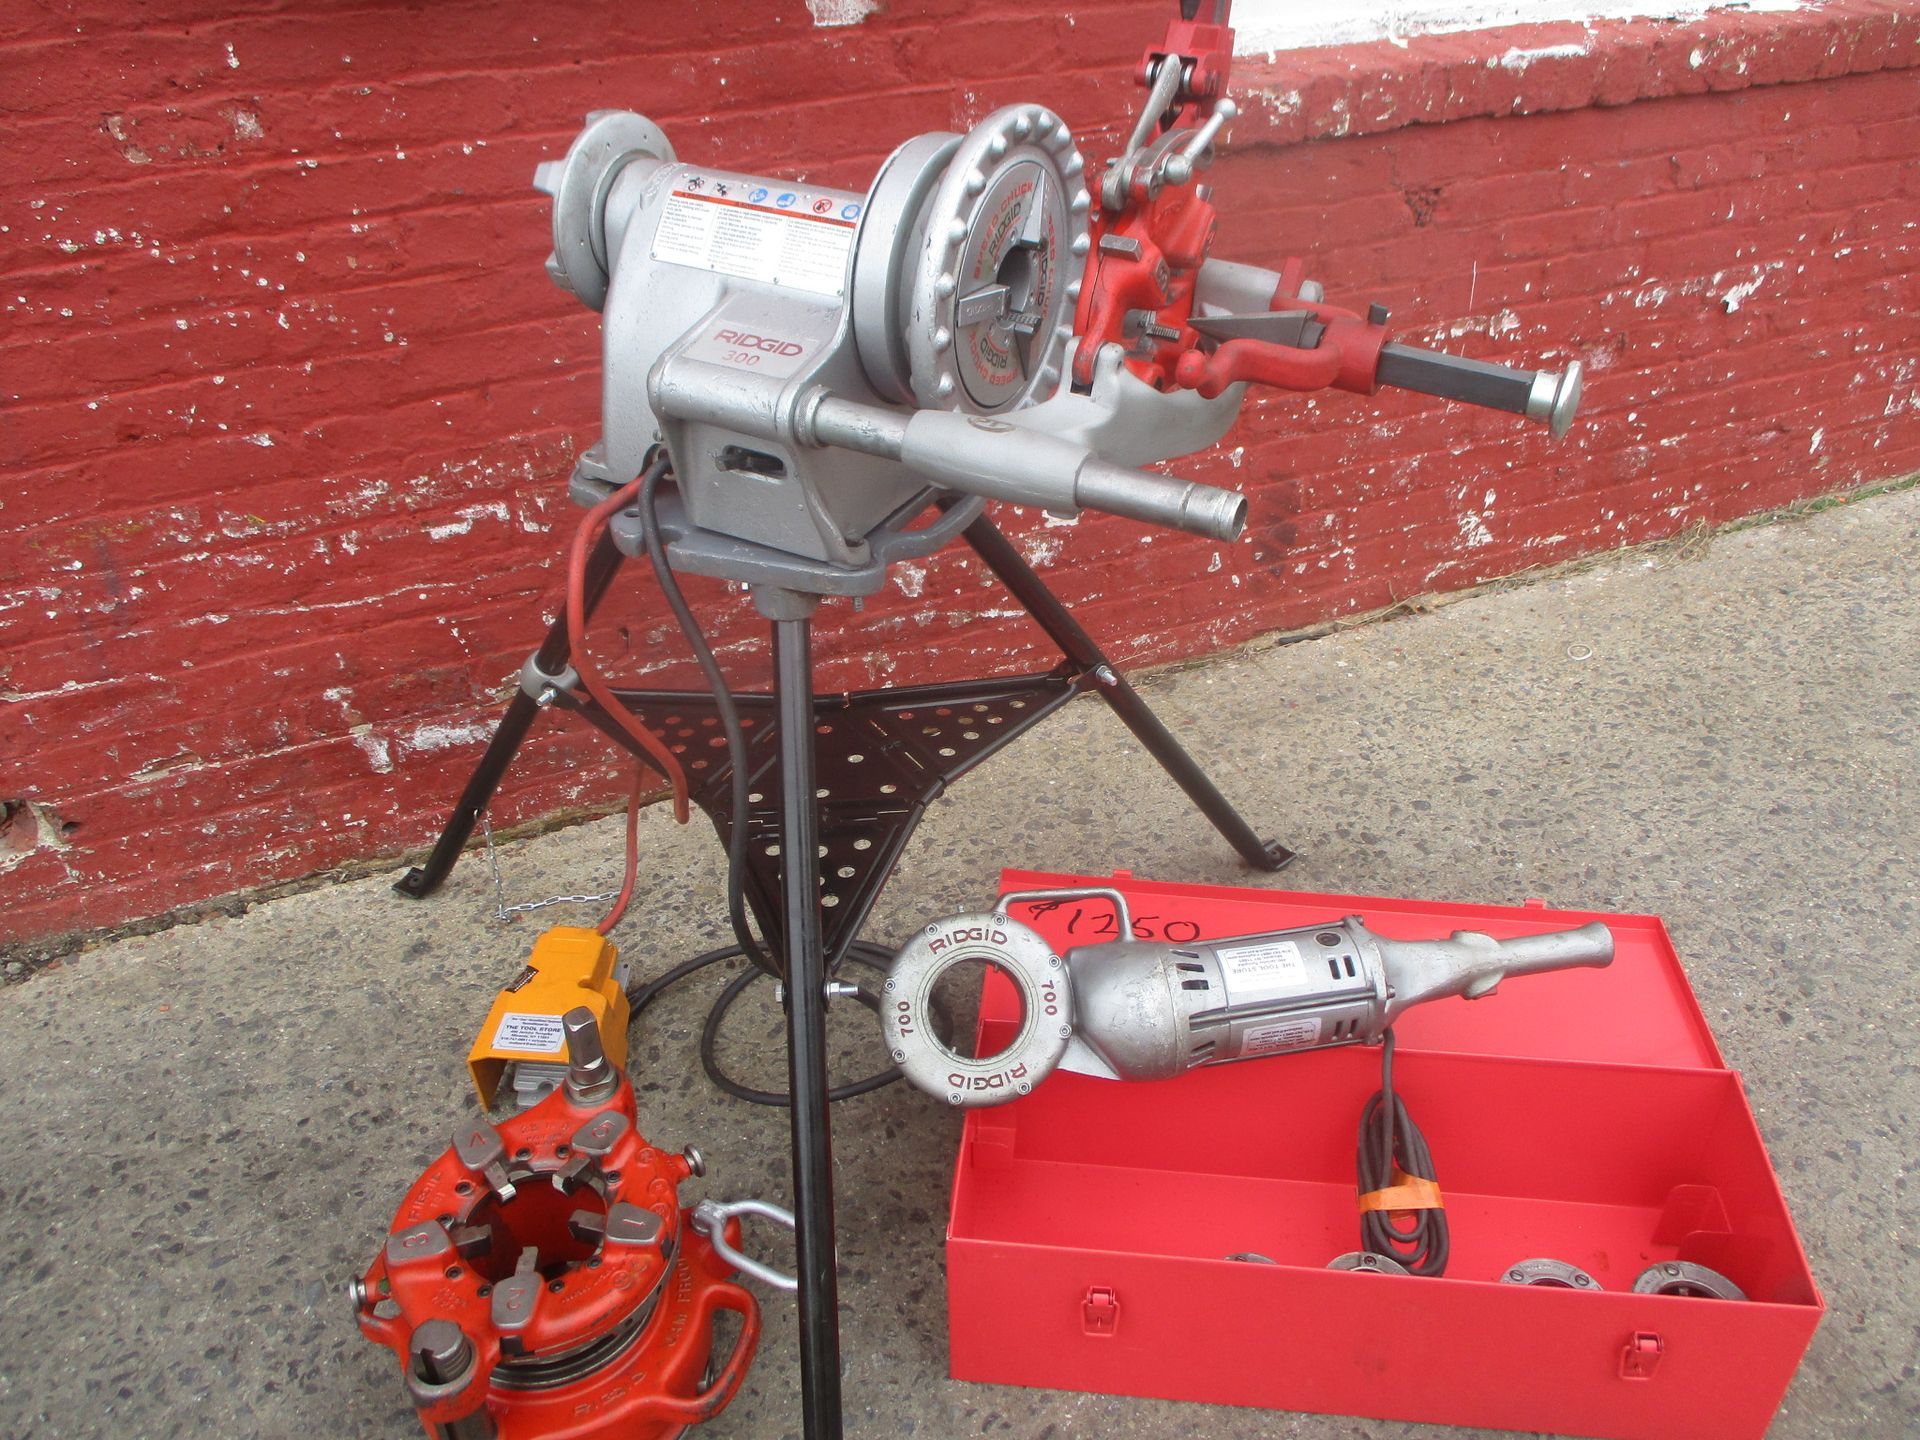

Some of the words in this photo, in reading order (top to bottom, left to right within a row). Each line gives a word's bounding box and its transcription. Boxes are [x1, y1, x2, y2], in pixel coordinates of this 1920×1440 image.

[1000, 181, 1034, 212] CHUCK
[989, 202, 1021, 257] RIDGID
[713, 328, 803, 357] RIDGID
[980, 337, 1008, 369] RIDGID
[721, 350, 760, 366] 300
[928, 928, 1008, 955] RIDGID
[1041, 980, 1058, 1016] 700
[897, 1001, 914, 1037] 700
[948, 1063, 1028, 1091] RIDGID
[623, 1218, 646, 1227] 1
[402, 1232, 429, 1249] 3
[506, 1288, 526, 1311] 2
